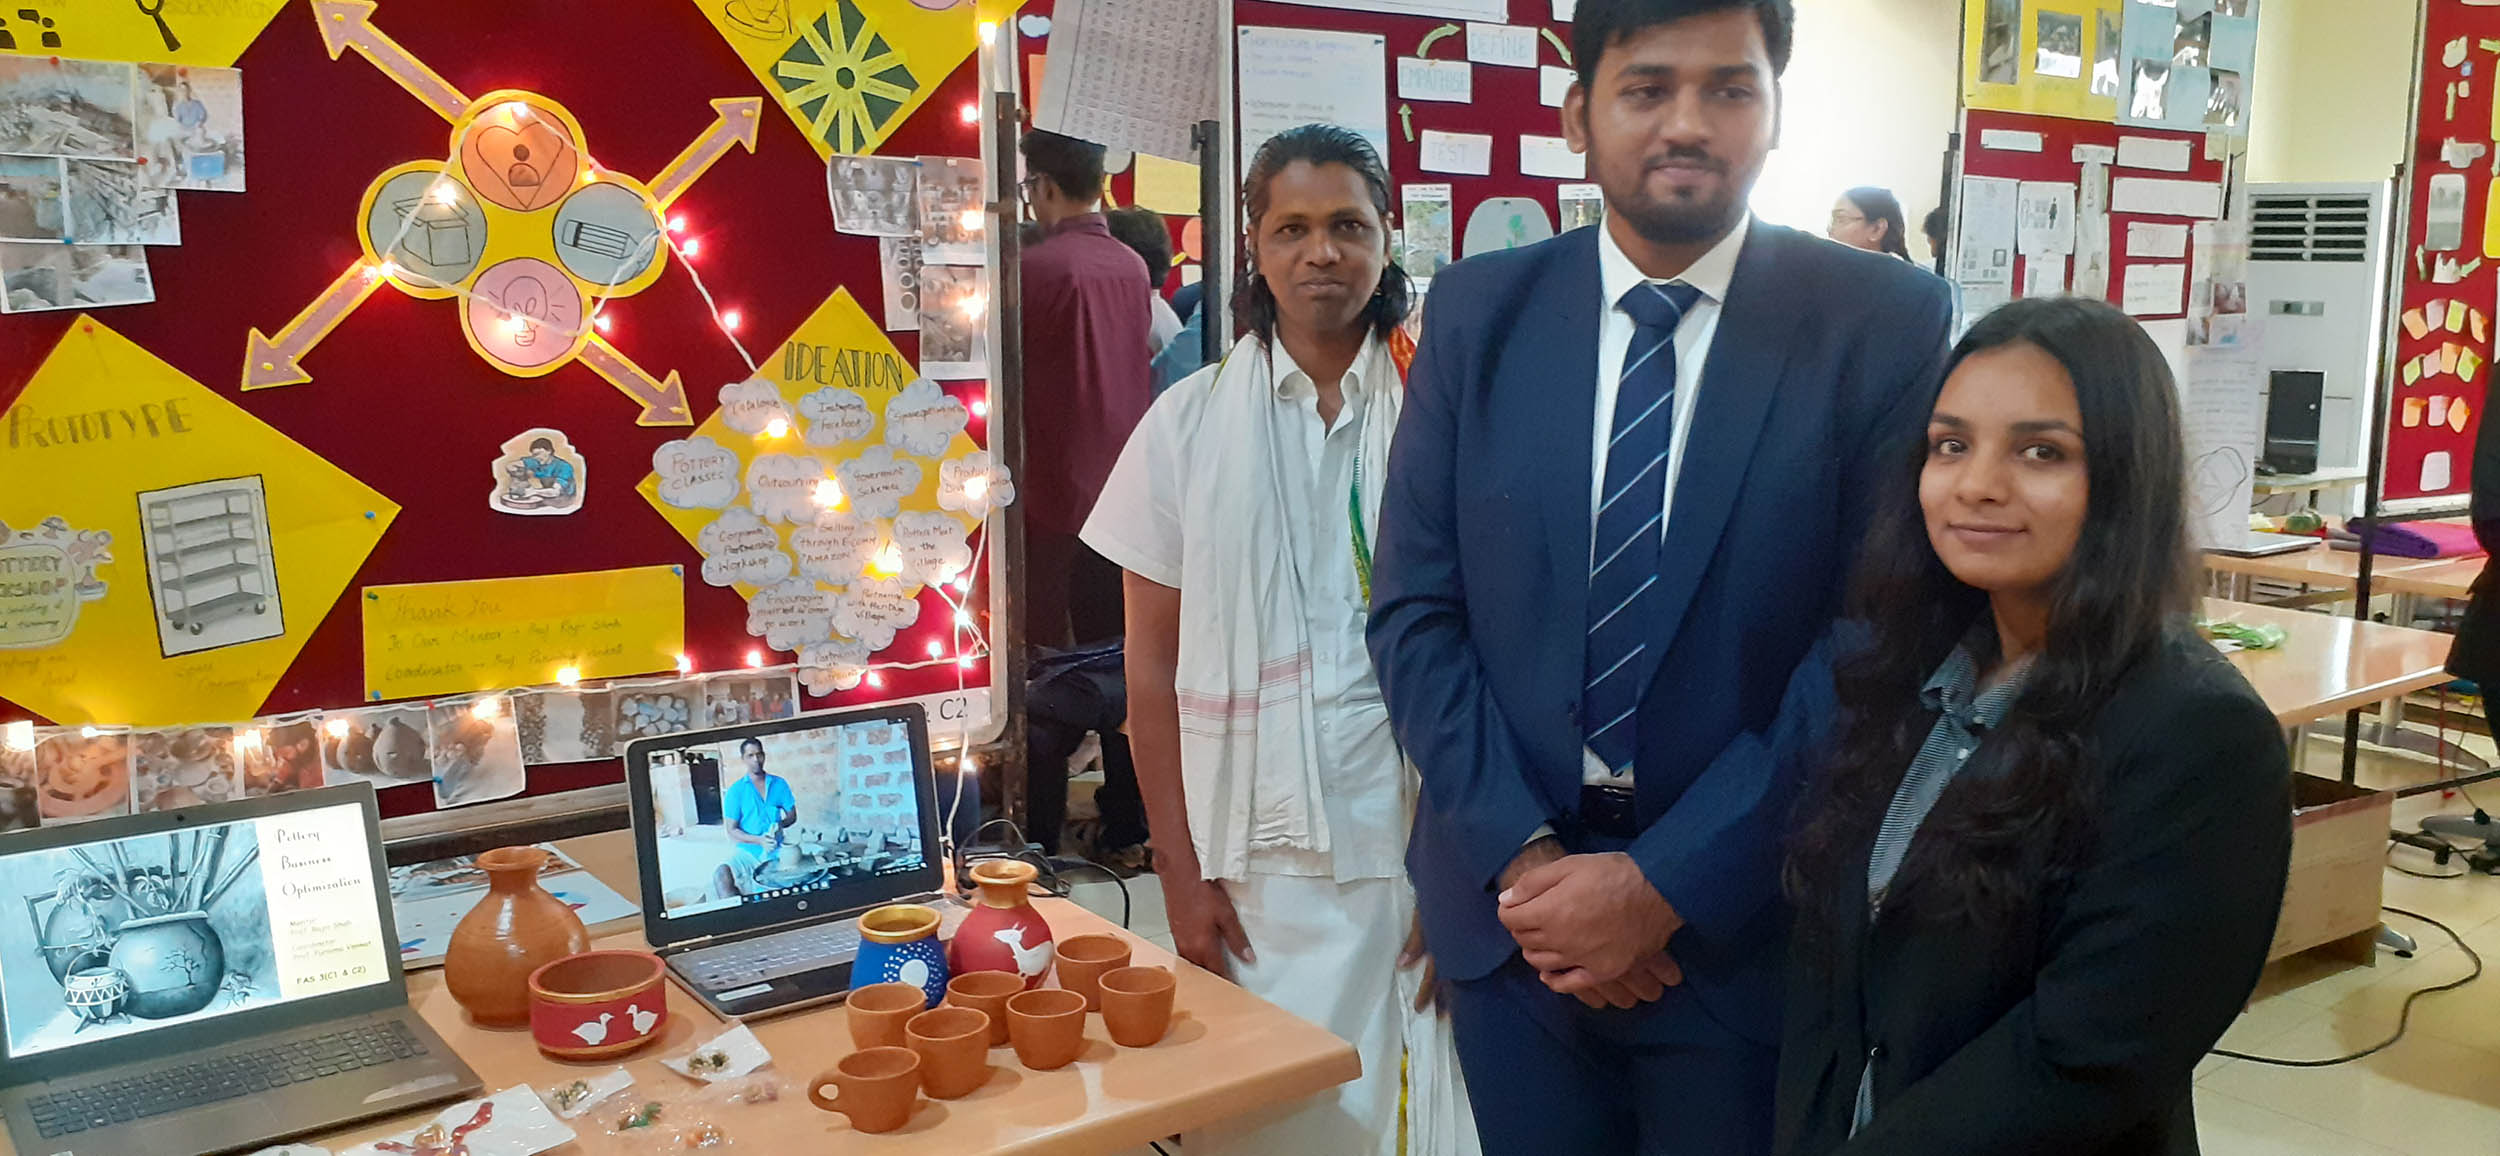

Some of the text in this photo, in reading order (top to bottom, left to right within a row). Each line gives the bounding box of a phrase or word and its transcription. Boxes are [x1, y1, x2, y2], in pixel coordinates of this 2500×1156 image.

[1431, 142, 1468, 163] TEST
[784, 341, 904, 393] IDEATION
[277, 828, 321, 844] Pottery
[281, 855, 332, 871] Business
[282, 878, 362, 900] Optimization
